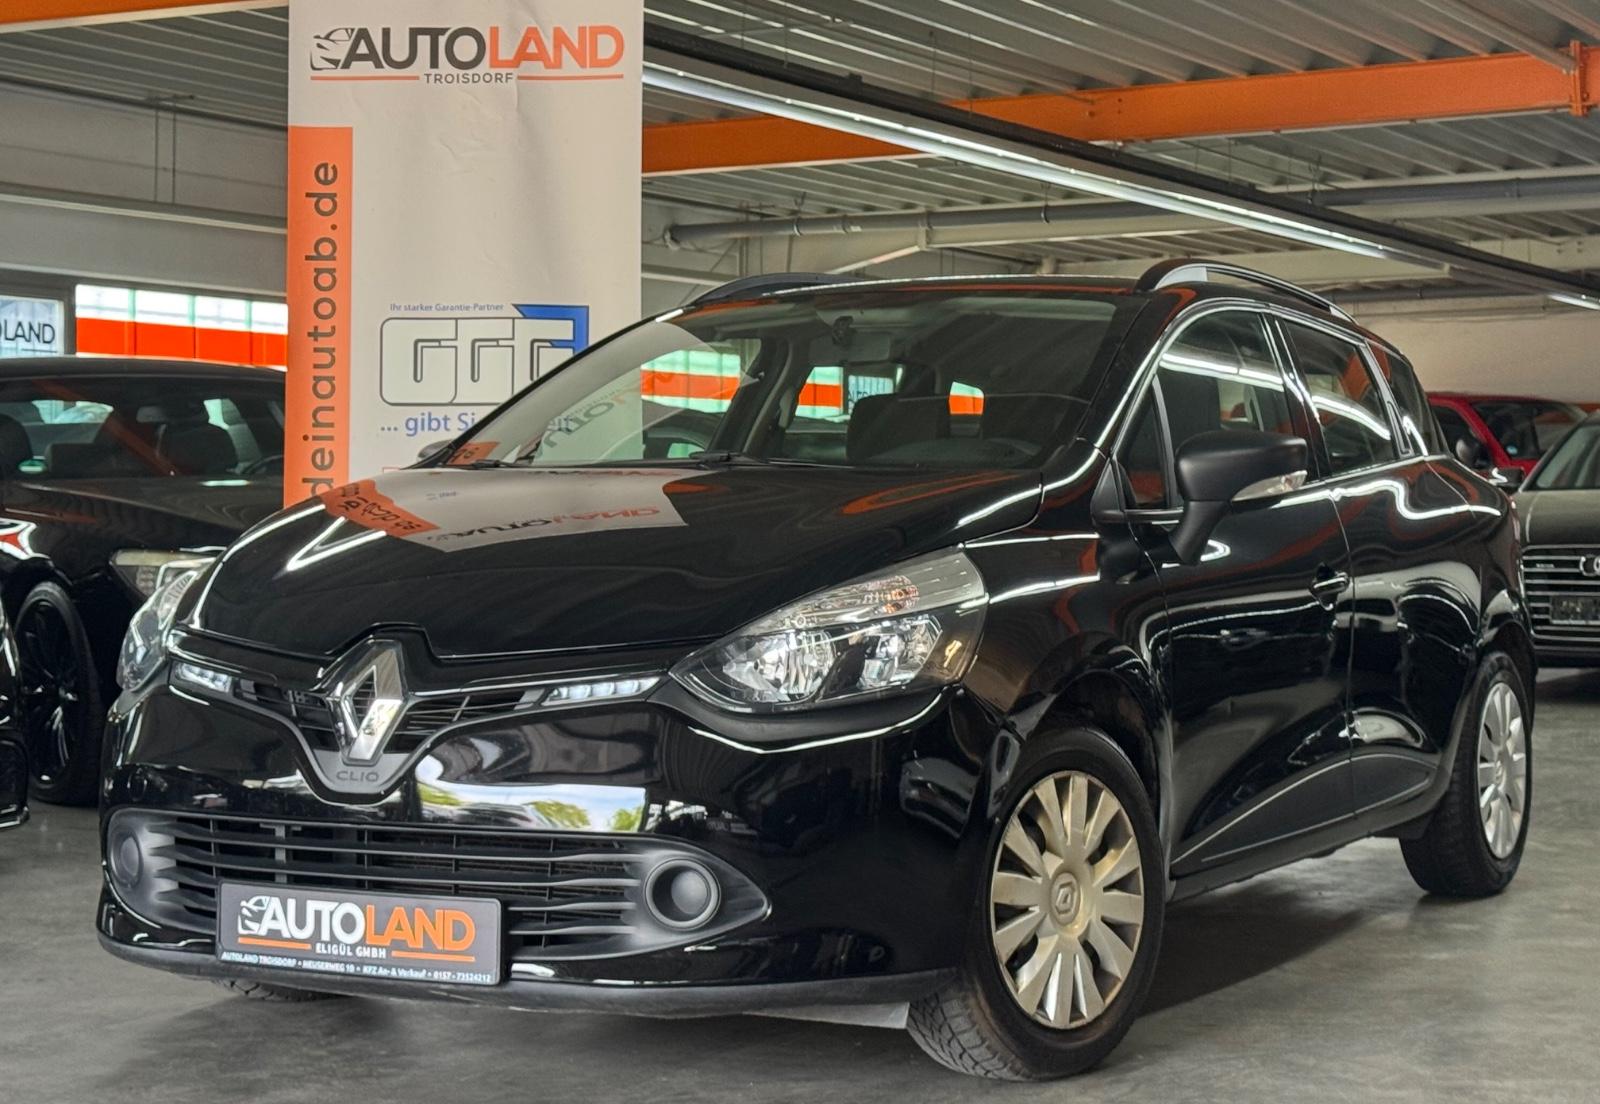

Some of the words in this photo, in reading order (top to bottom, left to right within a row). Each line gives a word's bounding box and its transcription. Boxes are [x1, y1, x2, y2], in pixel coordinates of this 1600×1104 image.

[341, 26, 625, 70] AUTOLAND
[424, 73, 514, 85] TROISDORF
[390, 303, 401, 311] Ihr
[404, 303, 433, 312] starker
[435, 303, 504, 312] Garantie-Partner
[0, 319, 56, 344] LAND
[405, 412, 450, 437] gibt
[457, 412, 475, 432] Si
[336, 770, 380, 783] CLIO
[257, 897, 476, 951] AUTOLAND
[315, 943, 352, 958] ELIGÜL
[355, 946, 386, 959] GMBH
